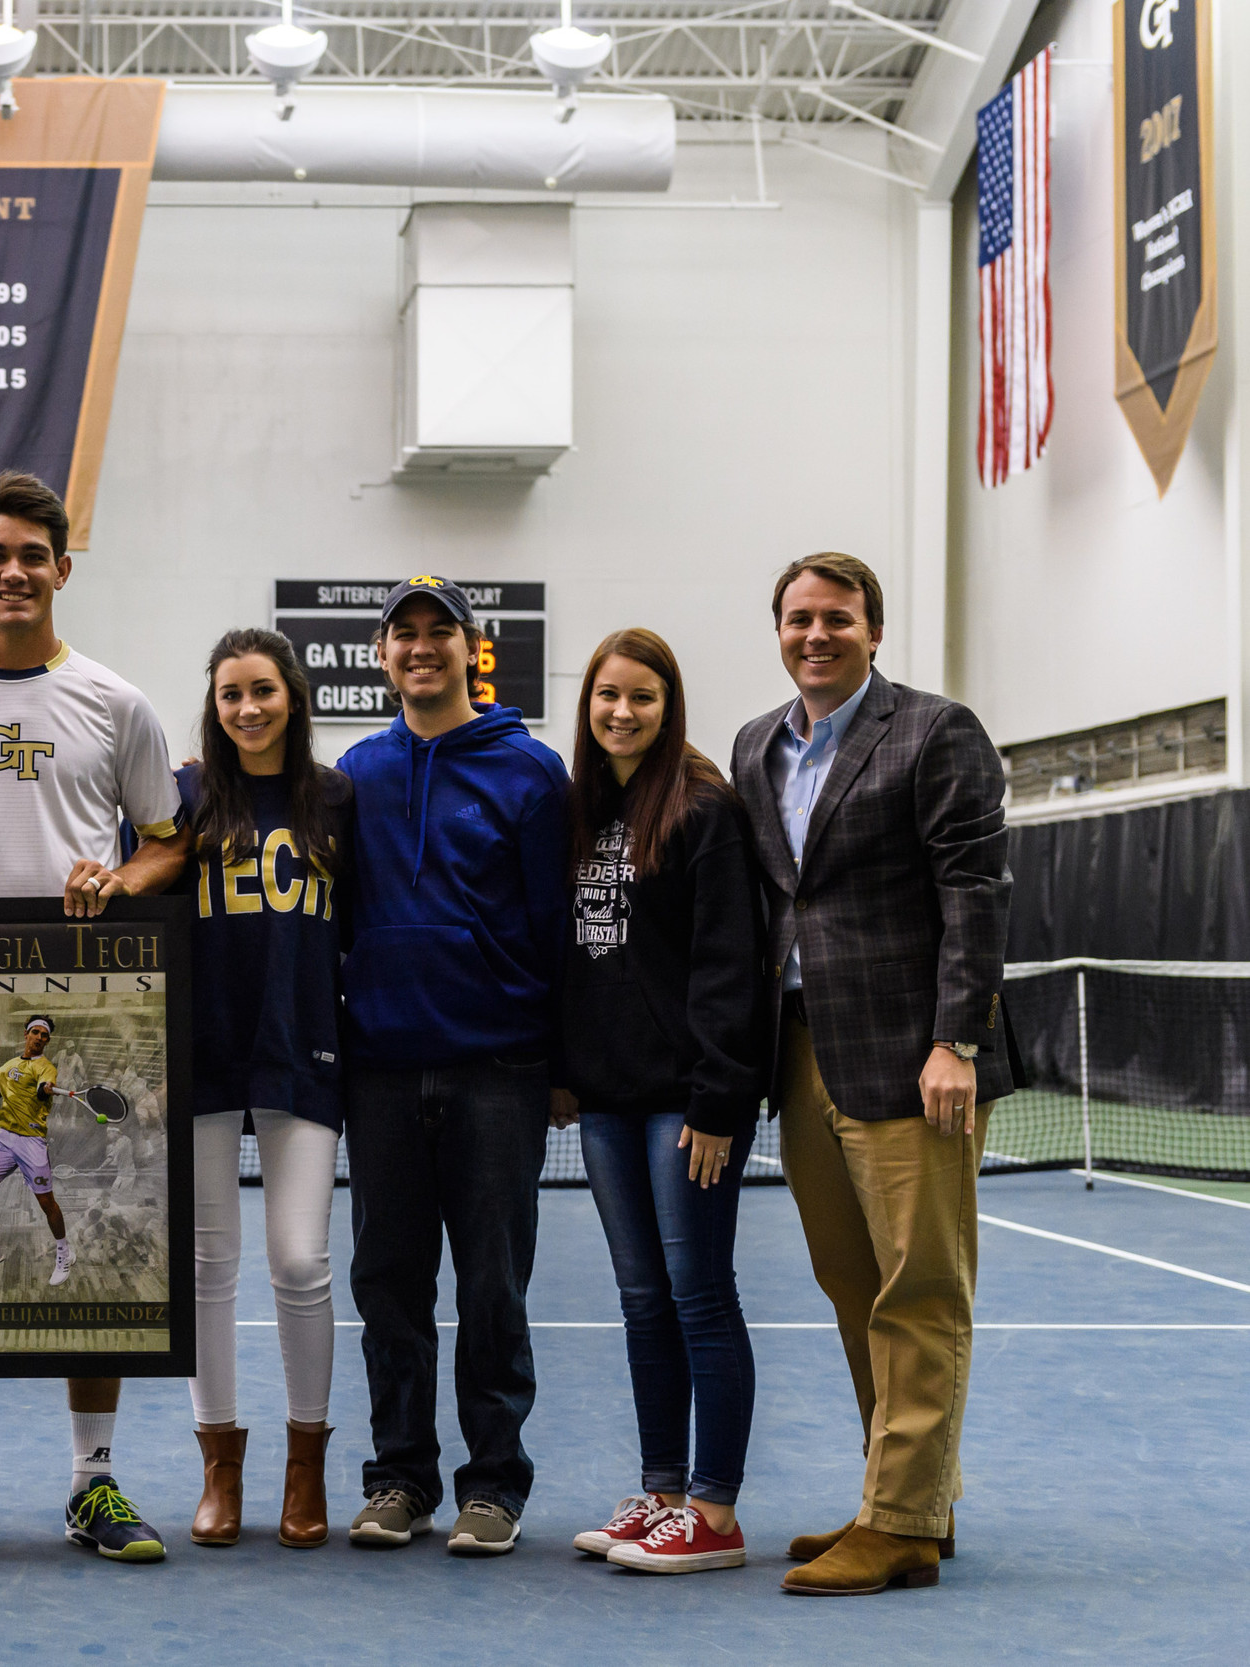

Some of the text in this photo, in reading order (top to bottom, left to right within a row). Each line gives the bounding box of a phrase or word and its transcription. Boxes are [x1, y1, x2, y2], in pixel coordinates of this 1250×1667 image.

[317, 585, 389, 605] SUTTERFIE
[305, 642, 381, 669] GA TEC
[316, 685, 388, 711] GUEST
[66, 923, 159, 969] TECH
[1, 1305, 167, 1325] ELIJAH MELENDEZ
